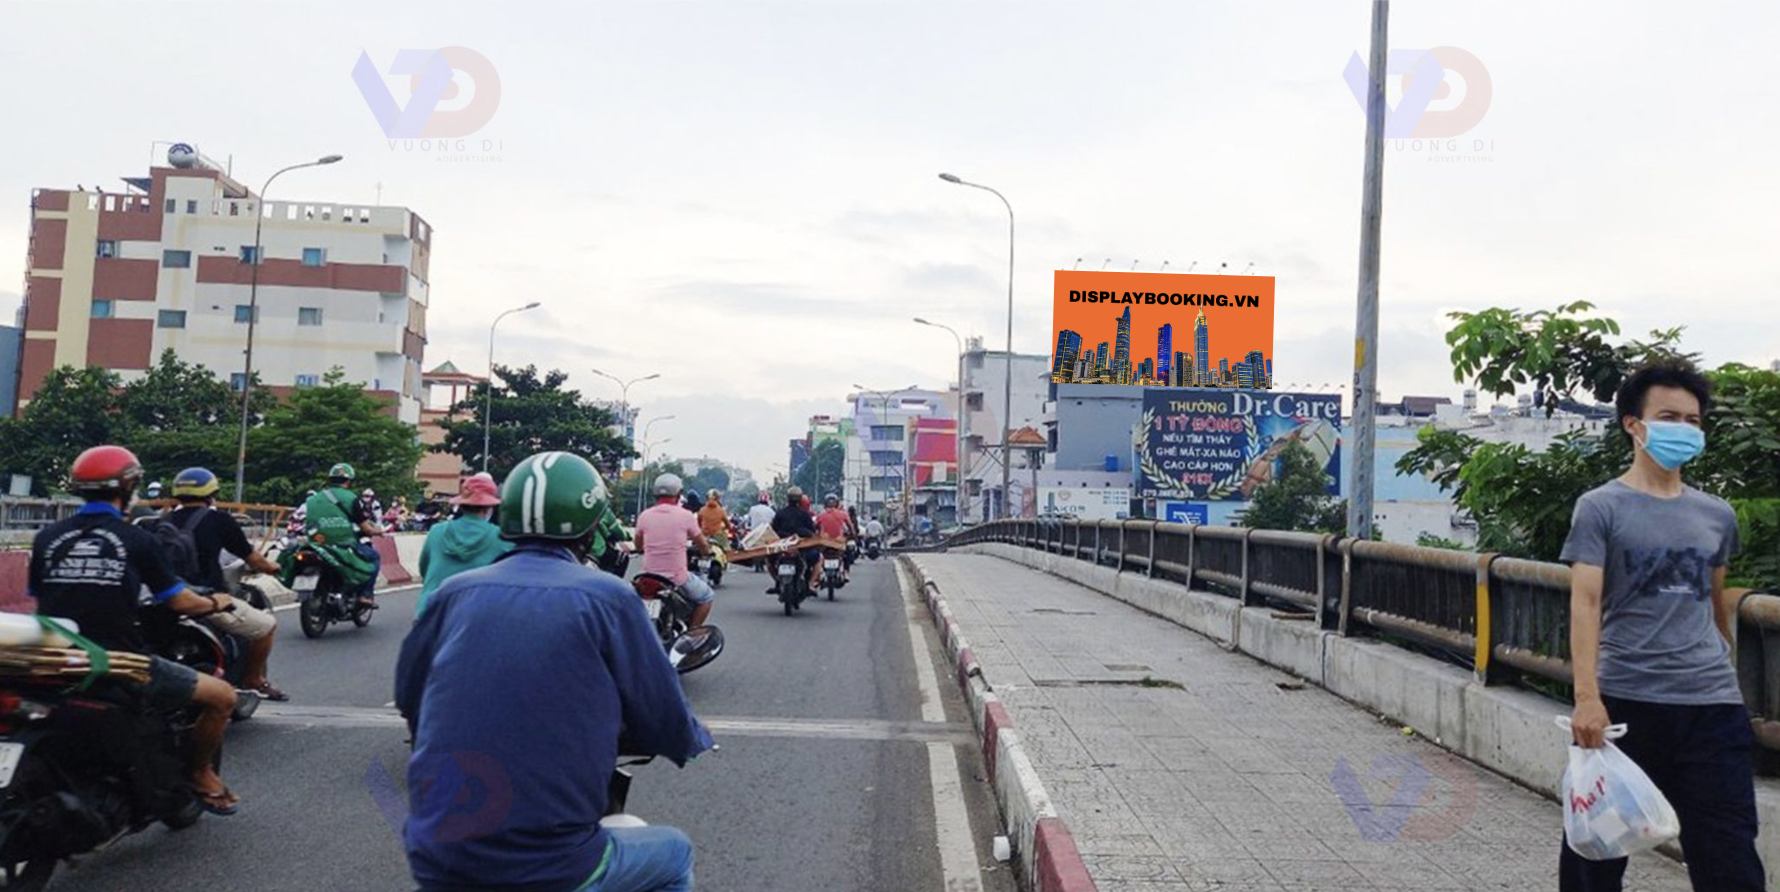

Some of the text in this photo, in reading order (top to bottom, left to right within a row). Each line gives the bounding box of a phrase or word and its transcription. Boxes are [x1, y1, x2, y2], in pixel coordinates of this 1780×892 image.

[1069, 290, 1259, 308] DISPLAYBOOKING.VN
[1232, 392, 1337, 418] Dr.Care
[1154, 415, 1162, 430] 1
[1163, 461, 1185, 470] CAO
